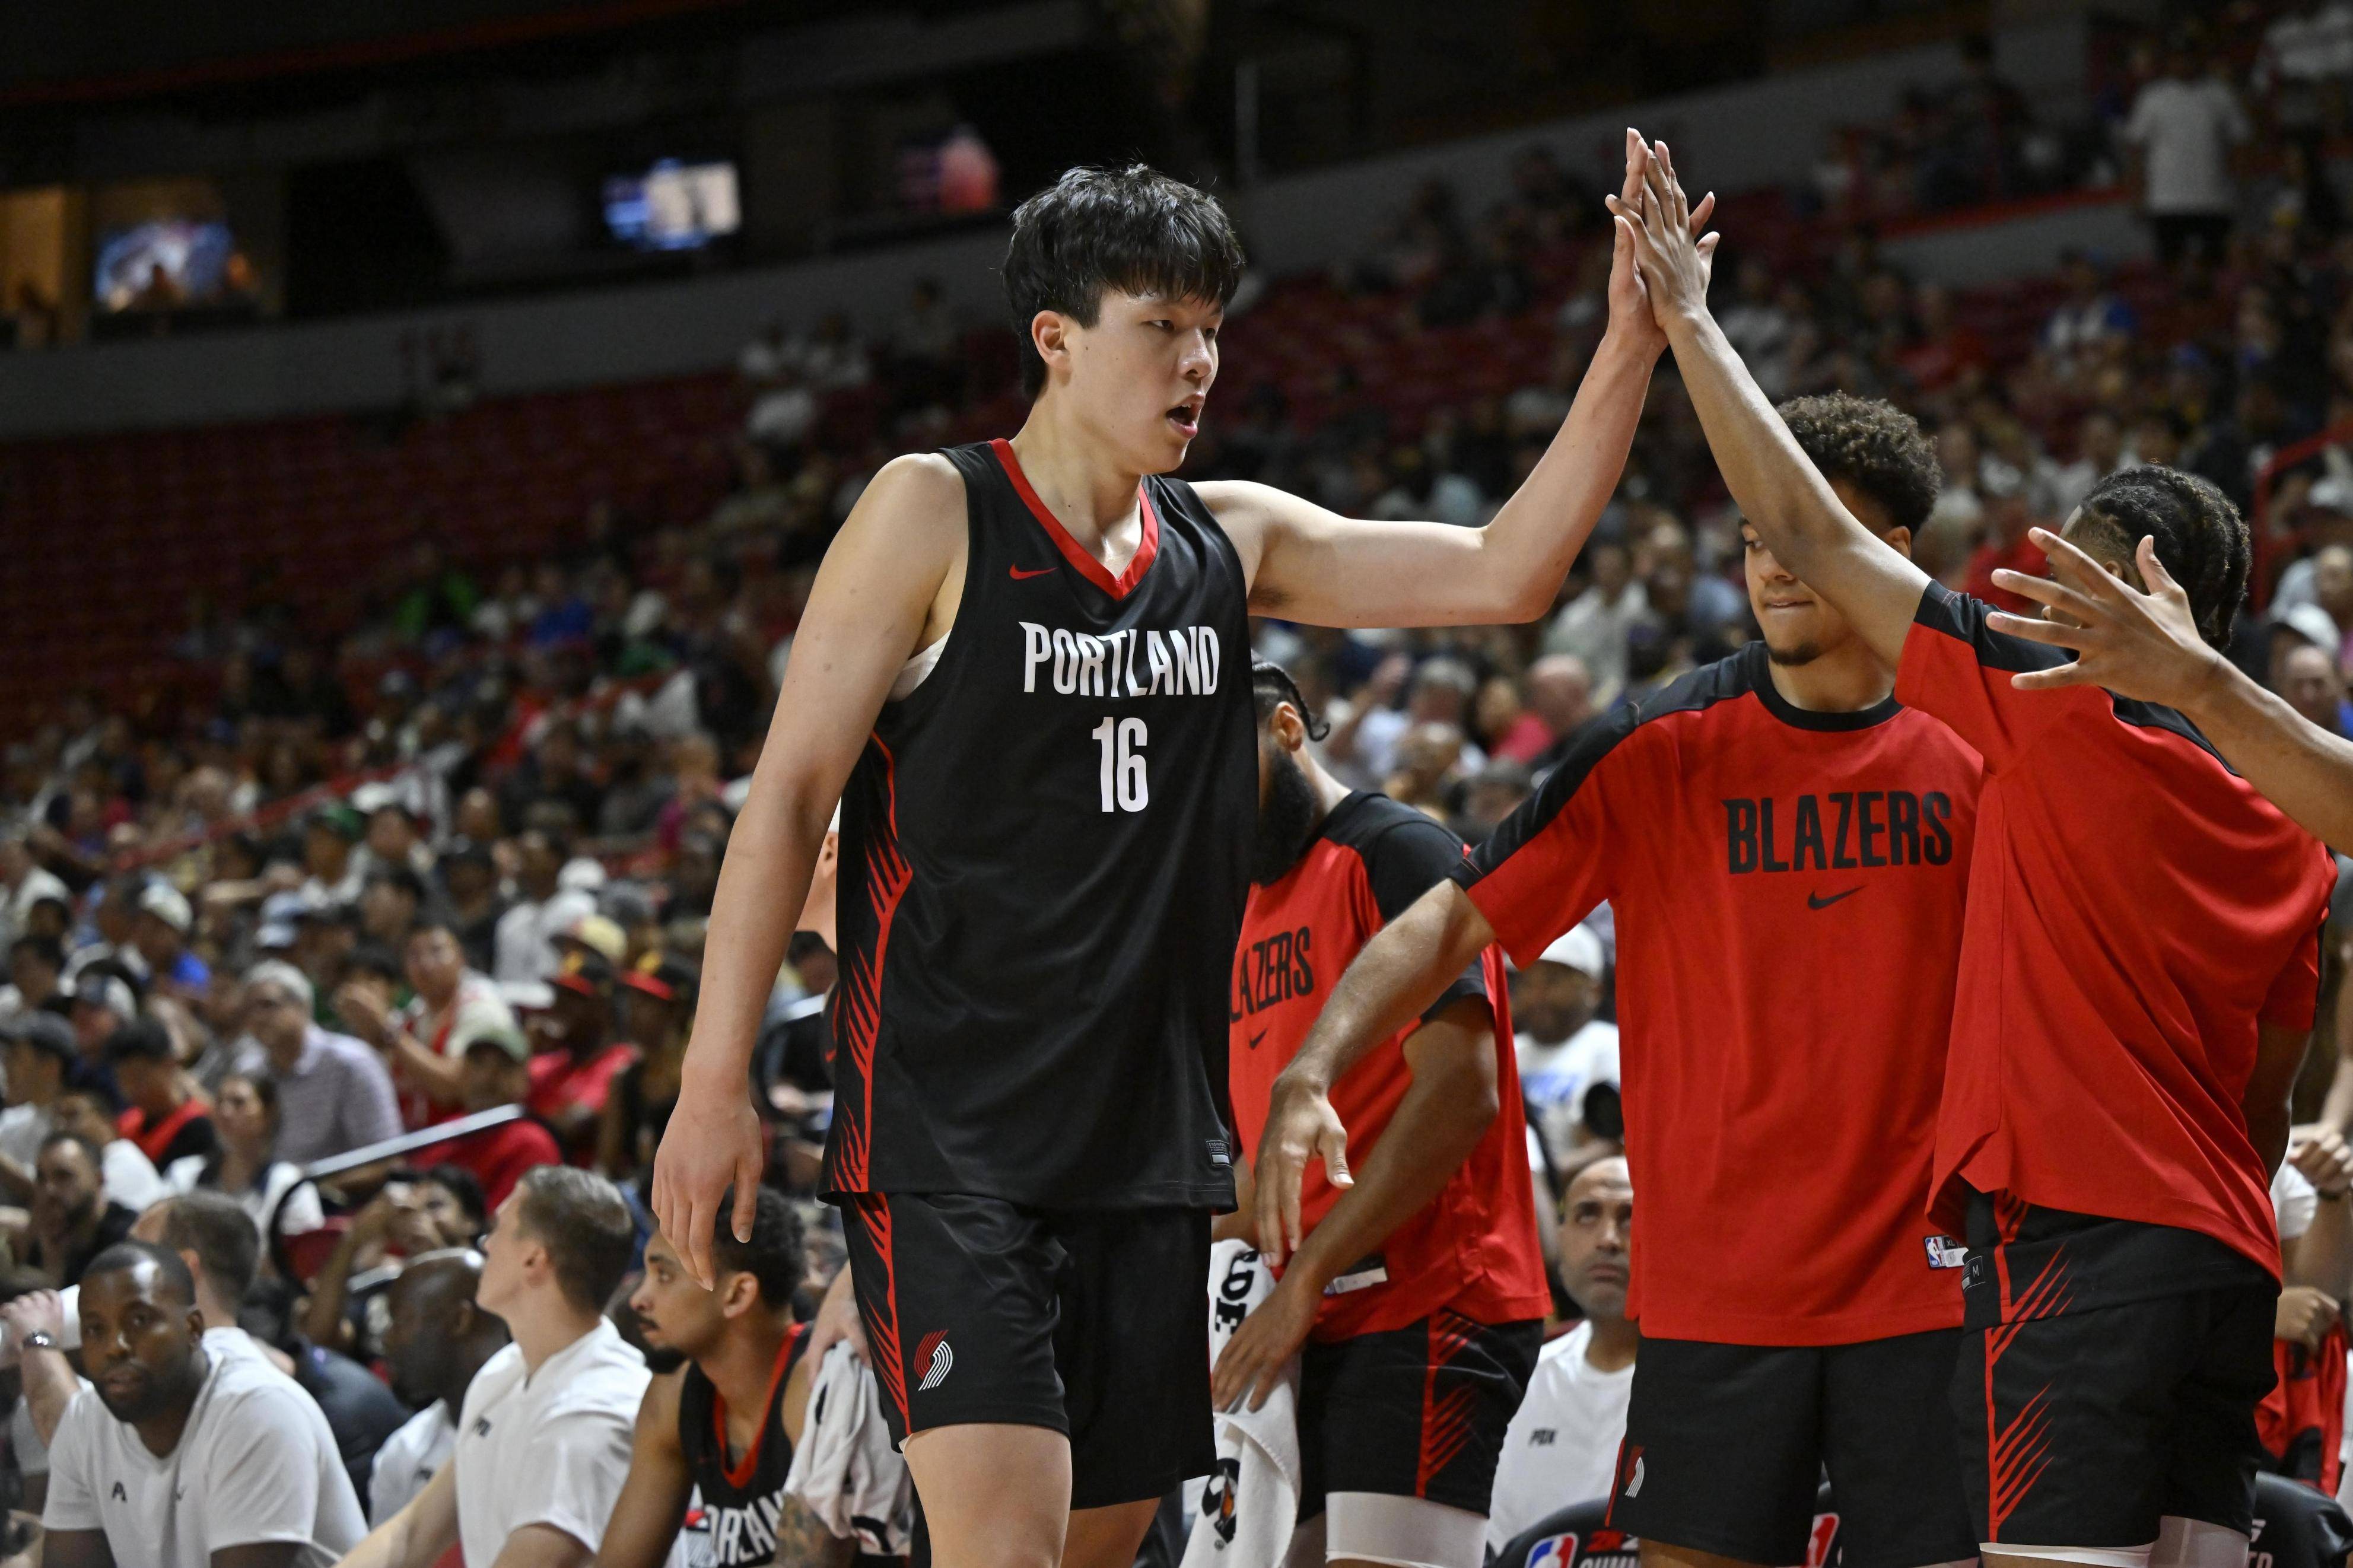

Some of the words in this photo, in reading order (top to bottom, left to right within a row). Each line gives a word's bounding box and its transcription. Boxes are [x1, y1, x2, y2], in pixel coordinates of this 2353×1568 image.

[1018, 622, 1220, 697] PORTLAND
[1092, 717, 1149, 812] 16
[1721, 791, 1953, 874] BLAZERS
[1230, 926, 1314, 1023] AZERS
[1972, 1264, 1980, 1278] M
